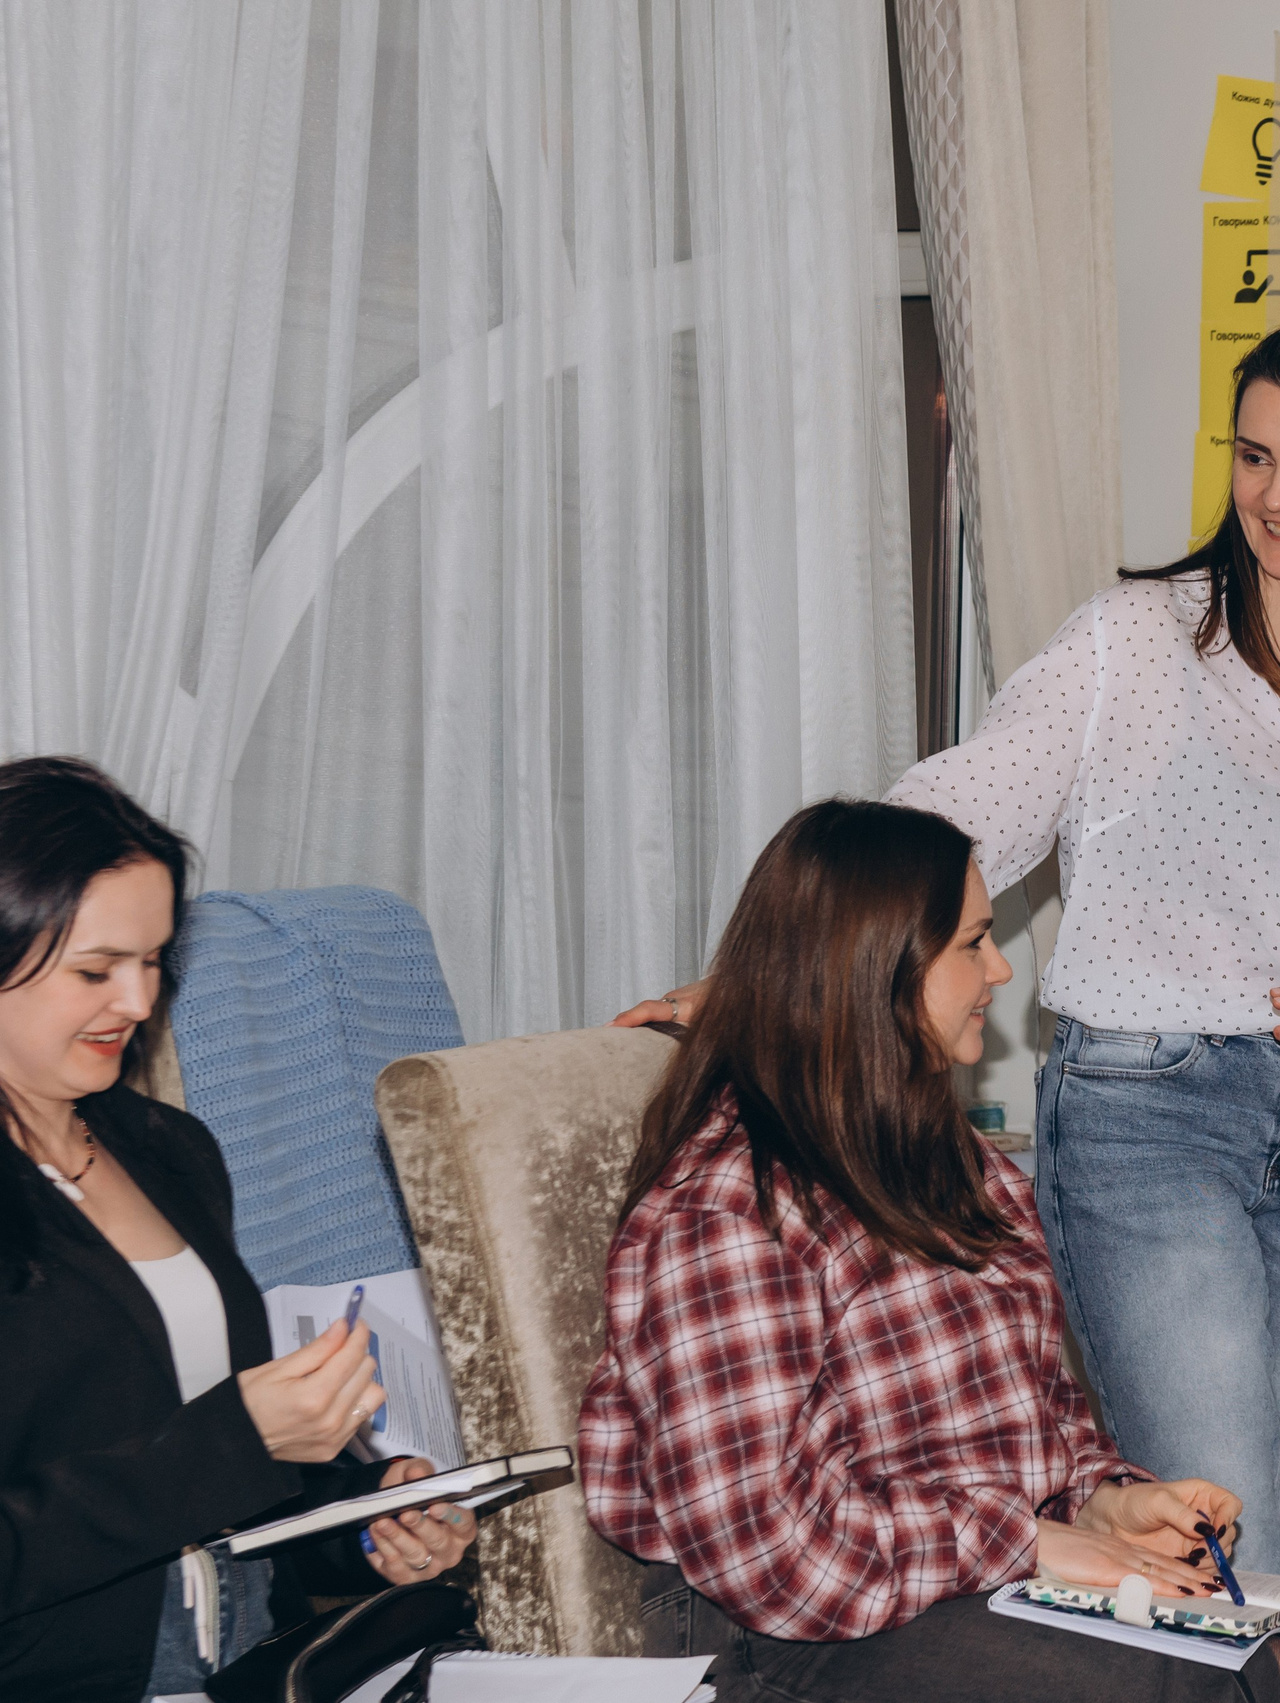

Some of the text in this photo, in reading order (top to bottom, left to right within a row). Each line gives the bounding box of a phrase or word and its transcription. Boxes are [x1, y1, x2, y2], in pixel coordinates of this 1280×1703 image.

[1232, 91, 1260, 104] Кожна
[1213, 216, 1259, 228] Говоримо
[1210, 330, 1261, 343] Говоримо
